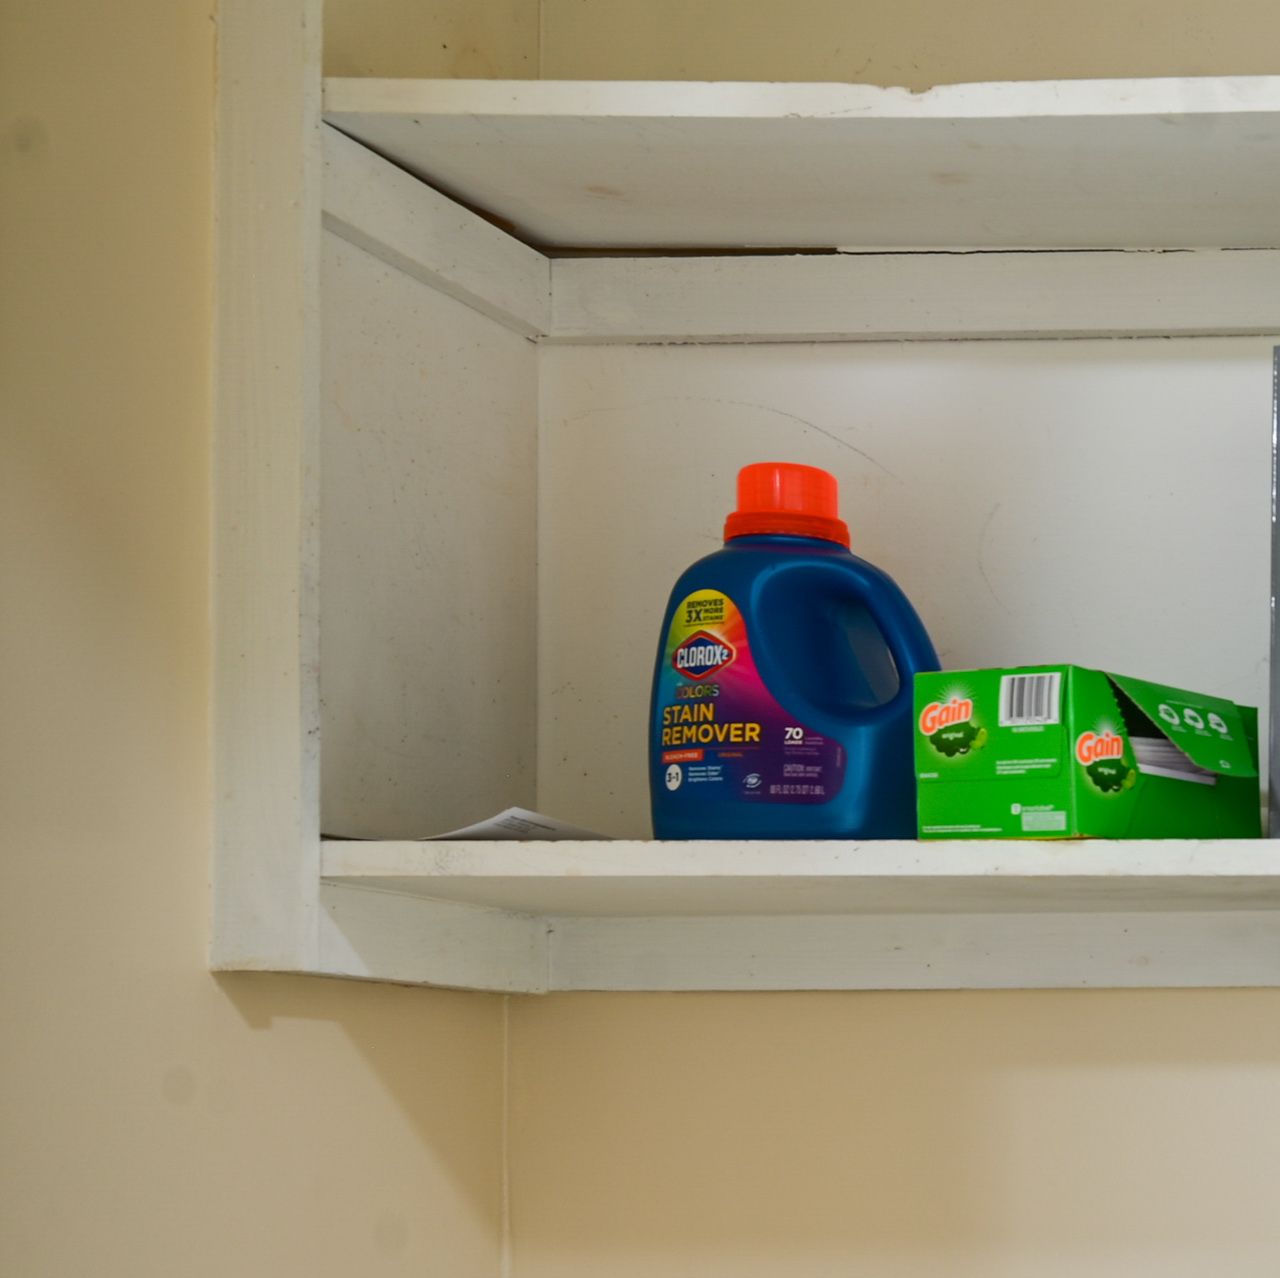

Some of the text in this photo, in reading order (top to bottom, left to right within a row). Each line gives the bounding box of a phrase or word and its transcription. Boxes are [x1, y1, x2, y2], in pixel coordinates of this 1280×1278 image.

[686, 609, 703, 623] 3X
[663, 702, 714, 725] STAIN
[920, 698, 972, 735] Gain
[662, 723, 761, 746] REMOVER
[784, 727, 804, 740] 70
[1076, 731, 1123, 765] Gain
